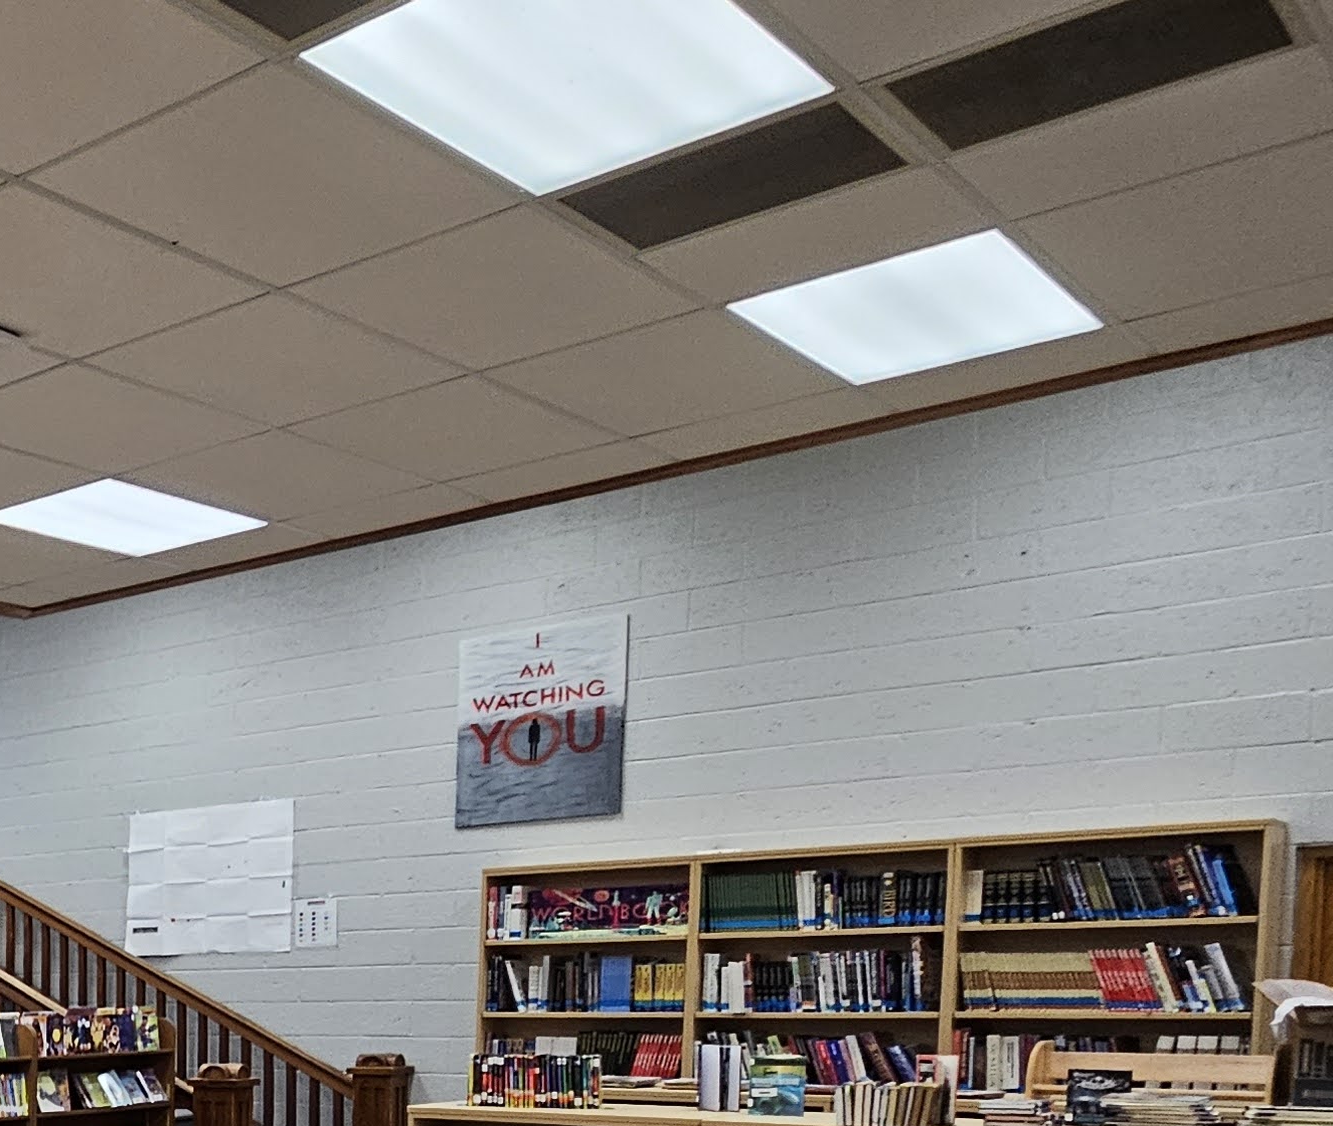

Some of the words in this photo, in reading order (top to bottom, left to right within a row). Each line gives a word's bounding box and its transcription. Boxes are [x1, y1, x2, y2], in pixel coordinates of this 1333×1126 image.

[535, 632, 541, 649] I
[519, 660, 555, 678] AM
[473, 679, 605, 713] WATCHING
[470, 705, 606, 767] YOU
